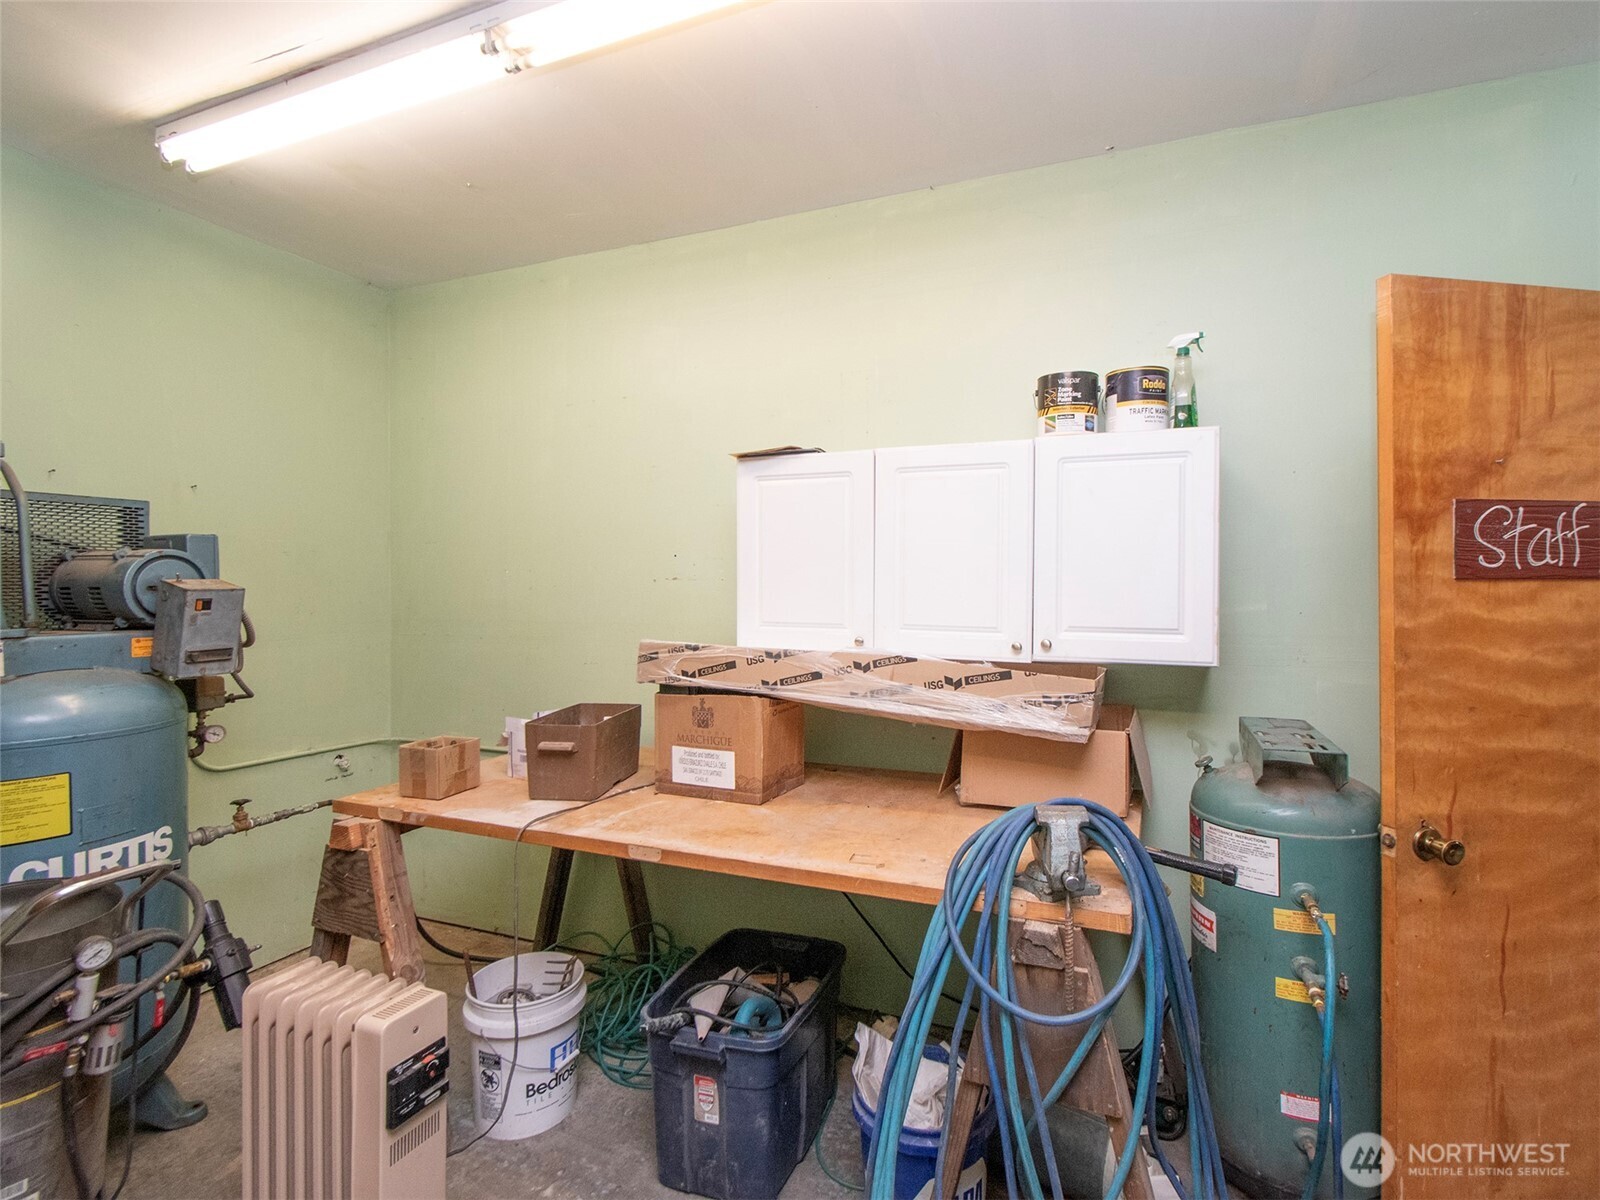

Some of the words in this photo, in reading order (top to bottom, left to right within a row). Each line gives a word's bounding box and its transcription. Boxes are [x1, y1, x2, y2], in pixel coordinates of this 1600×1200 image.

[1058, 376, 1081, 385] valspar
[1142, 378, 1166, 390] Rodda
[1129, 407, 1154, 416] TRAFFIC
[1473, 502, 1590, 570] Staff
[746, 655, 765, 666] USG
[876, 655, 908, 668] CEILINGS
[700, 663, 728, 676] CEILINGS
[782, 673, 813, 686] CEILINGS
[923, 679, 944, 691] USG
[968, 671, 1001, 685] CEILINGS
[676, 733, 733, 747] MARCHIGUE
[1234, 832, 1268, 845] INSTRUCTIONS
[8, 825, 174, 883] CURTIS
